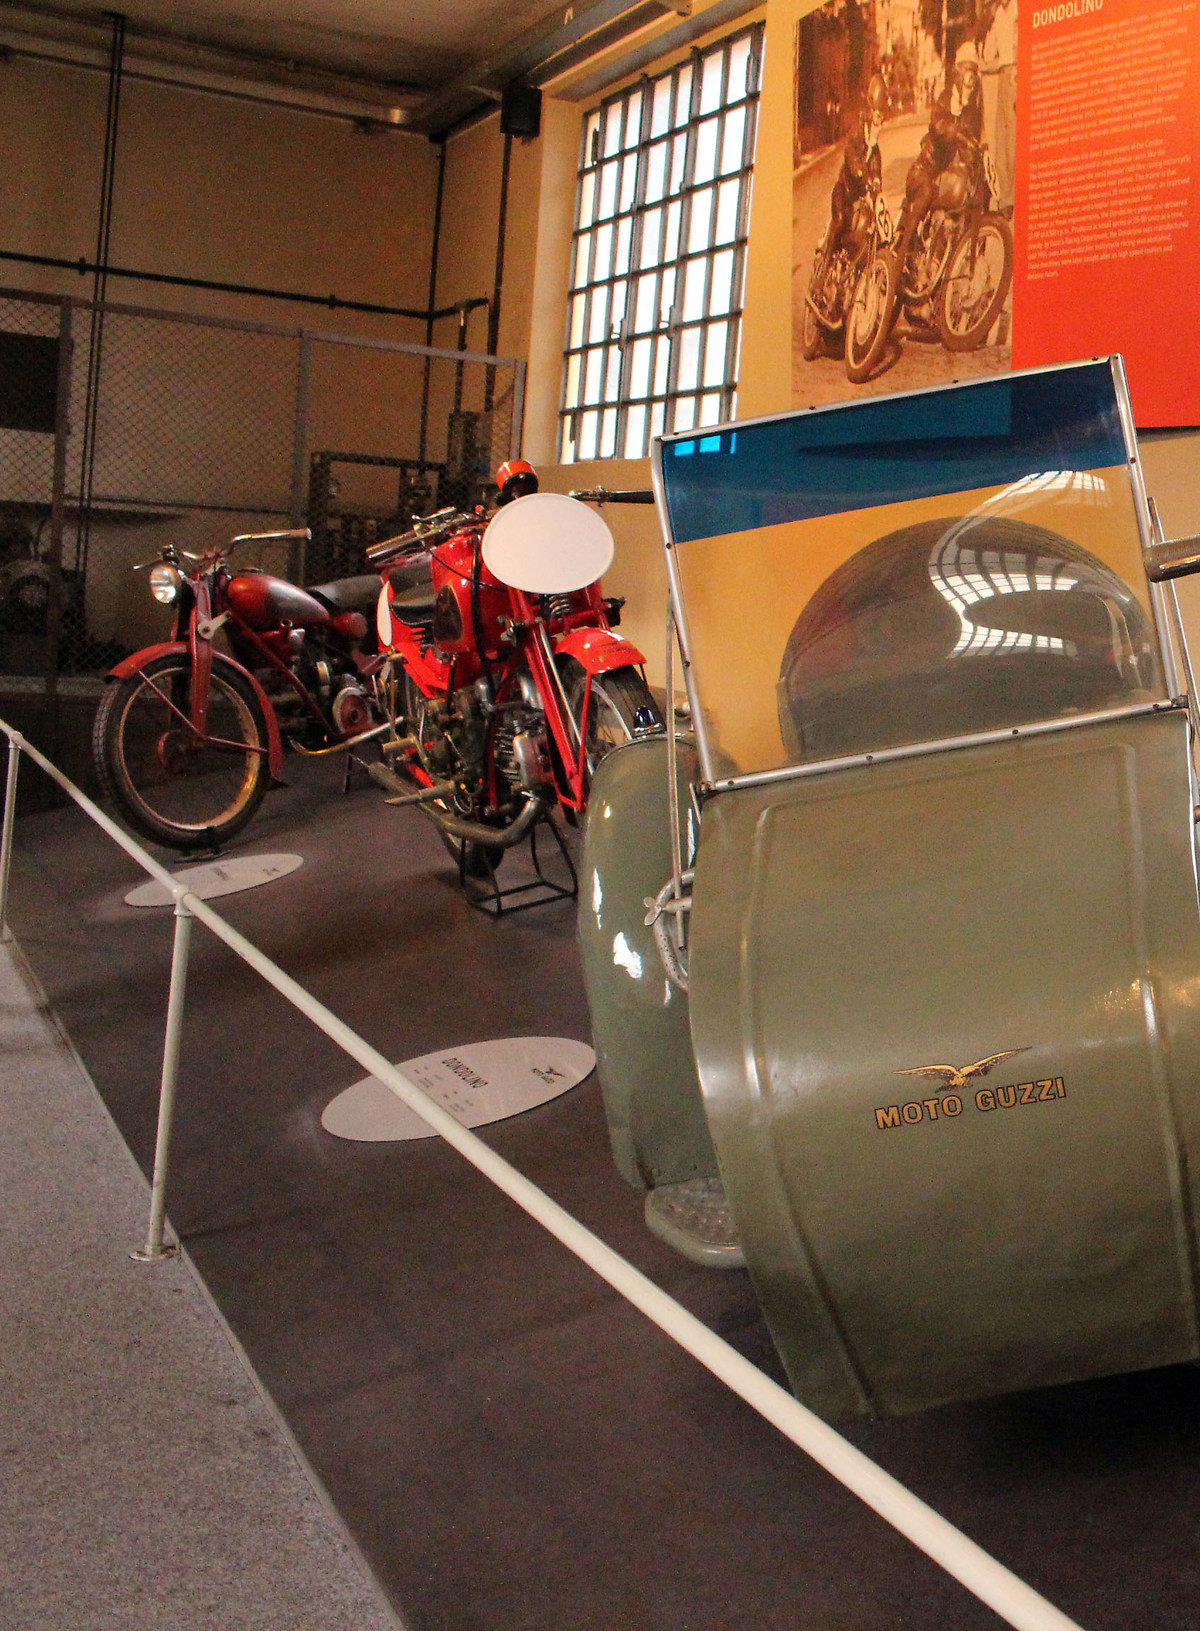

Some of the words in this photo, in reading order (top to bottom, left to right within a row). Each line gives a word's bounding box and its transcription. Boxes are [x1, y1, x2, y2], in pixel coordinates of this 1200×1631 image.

[1032, 0, 1104, 29] DONDOLINO
[441, 1057, 488, 1088] DONDOLINO
[874, 1095, 963, 1129] MOTO
[974, 1076, 1067, 1112] GUZZI
